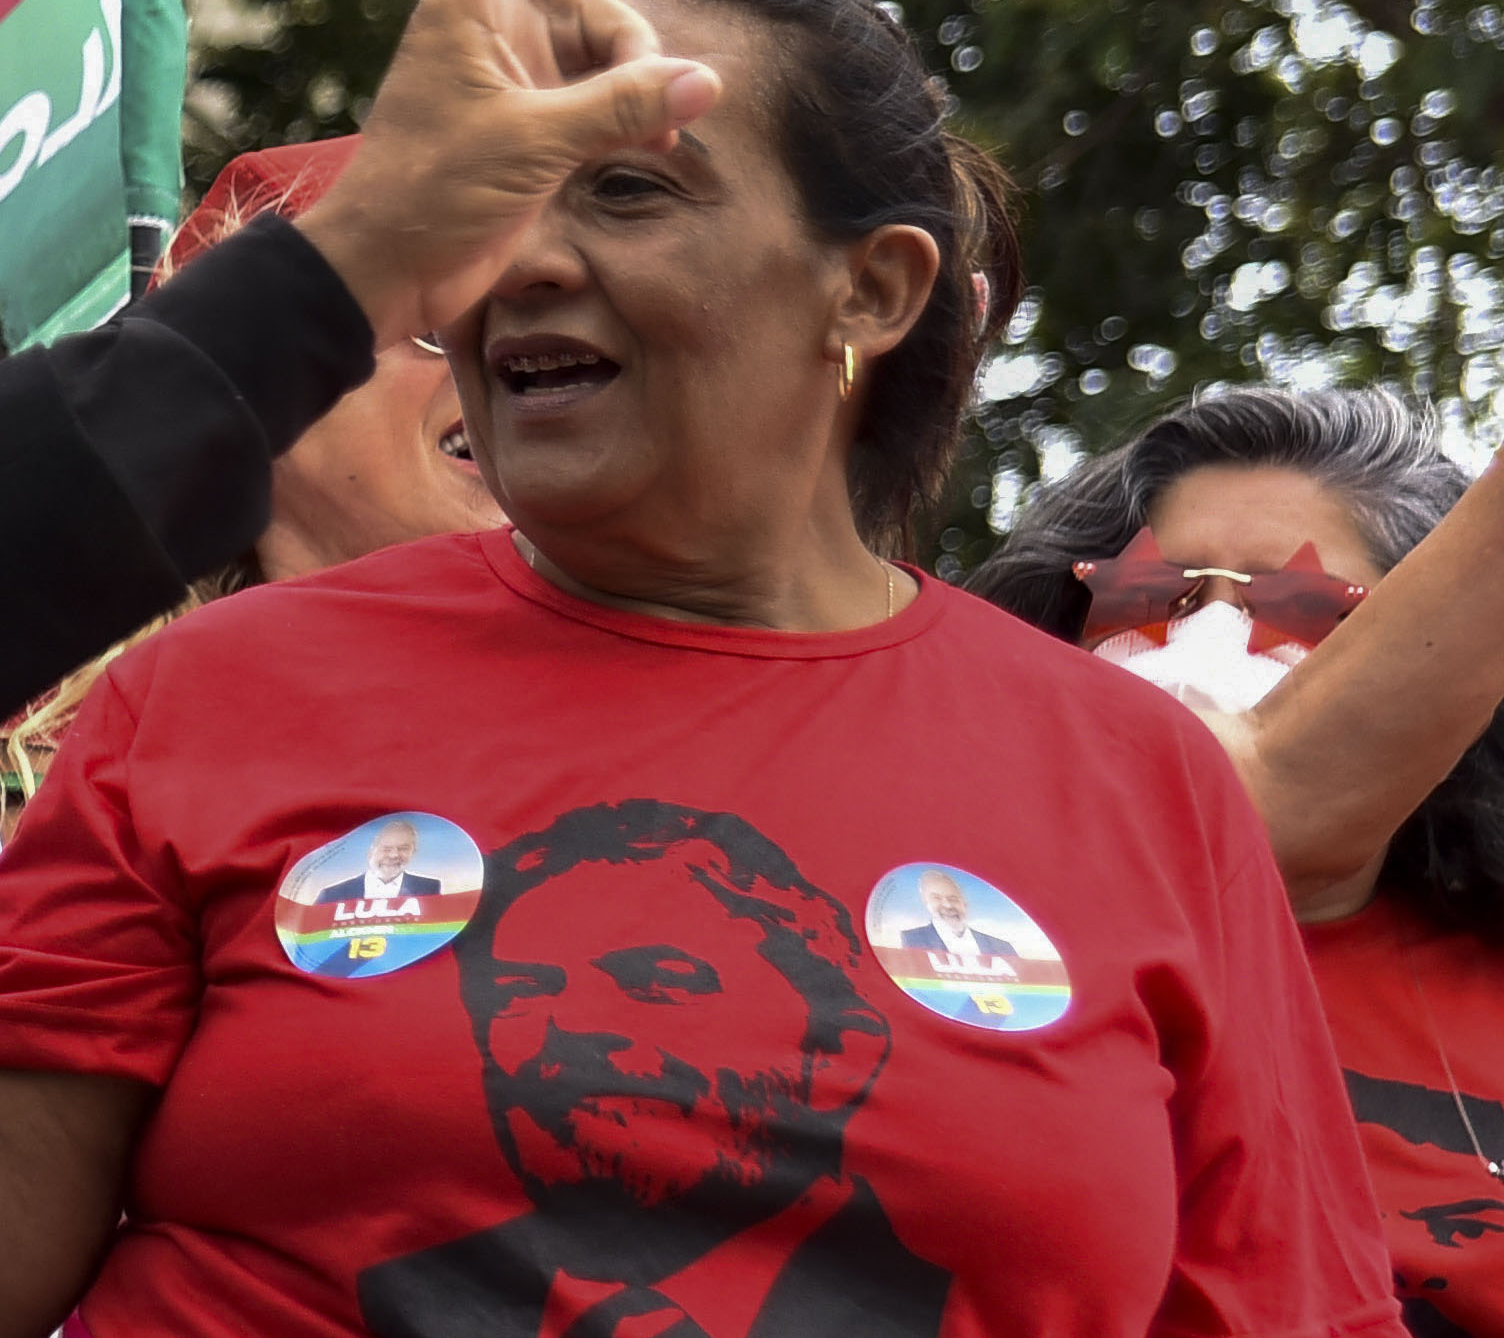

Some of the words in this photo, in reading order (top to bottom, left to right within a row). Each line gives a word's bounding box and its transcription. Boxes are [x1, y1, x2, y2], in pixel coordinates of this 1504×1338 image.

[334, 897, 421, 921] LULA
[348, 936, 387, 960] 13
[926, 951, 1017, 977] LULA
